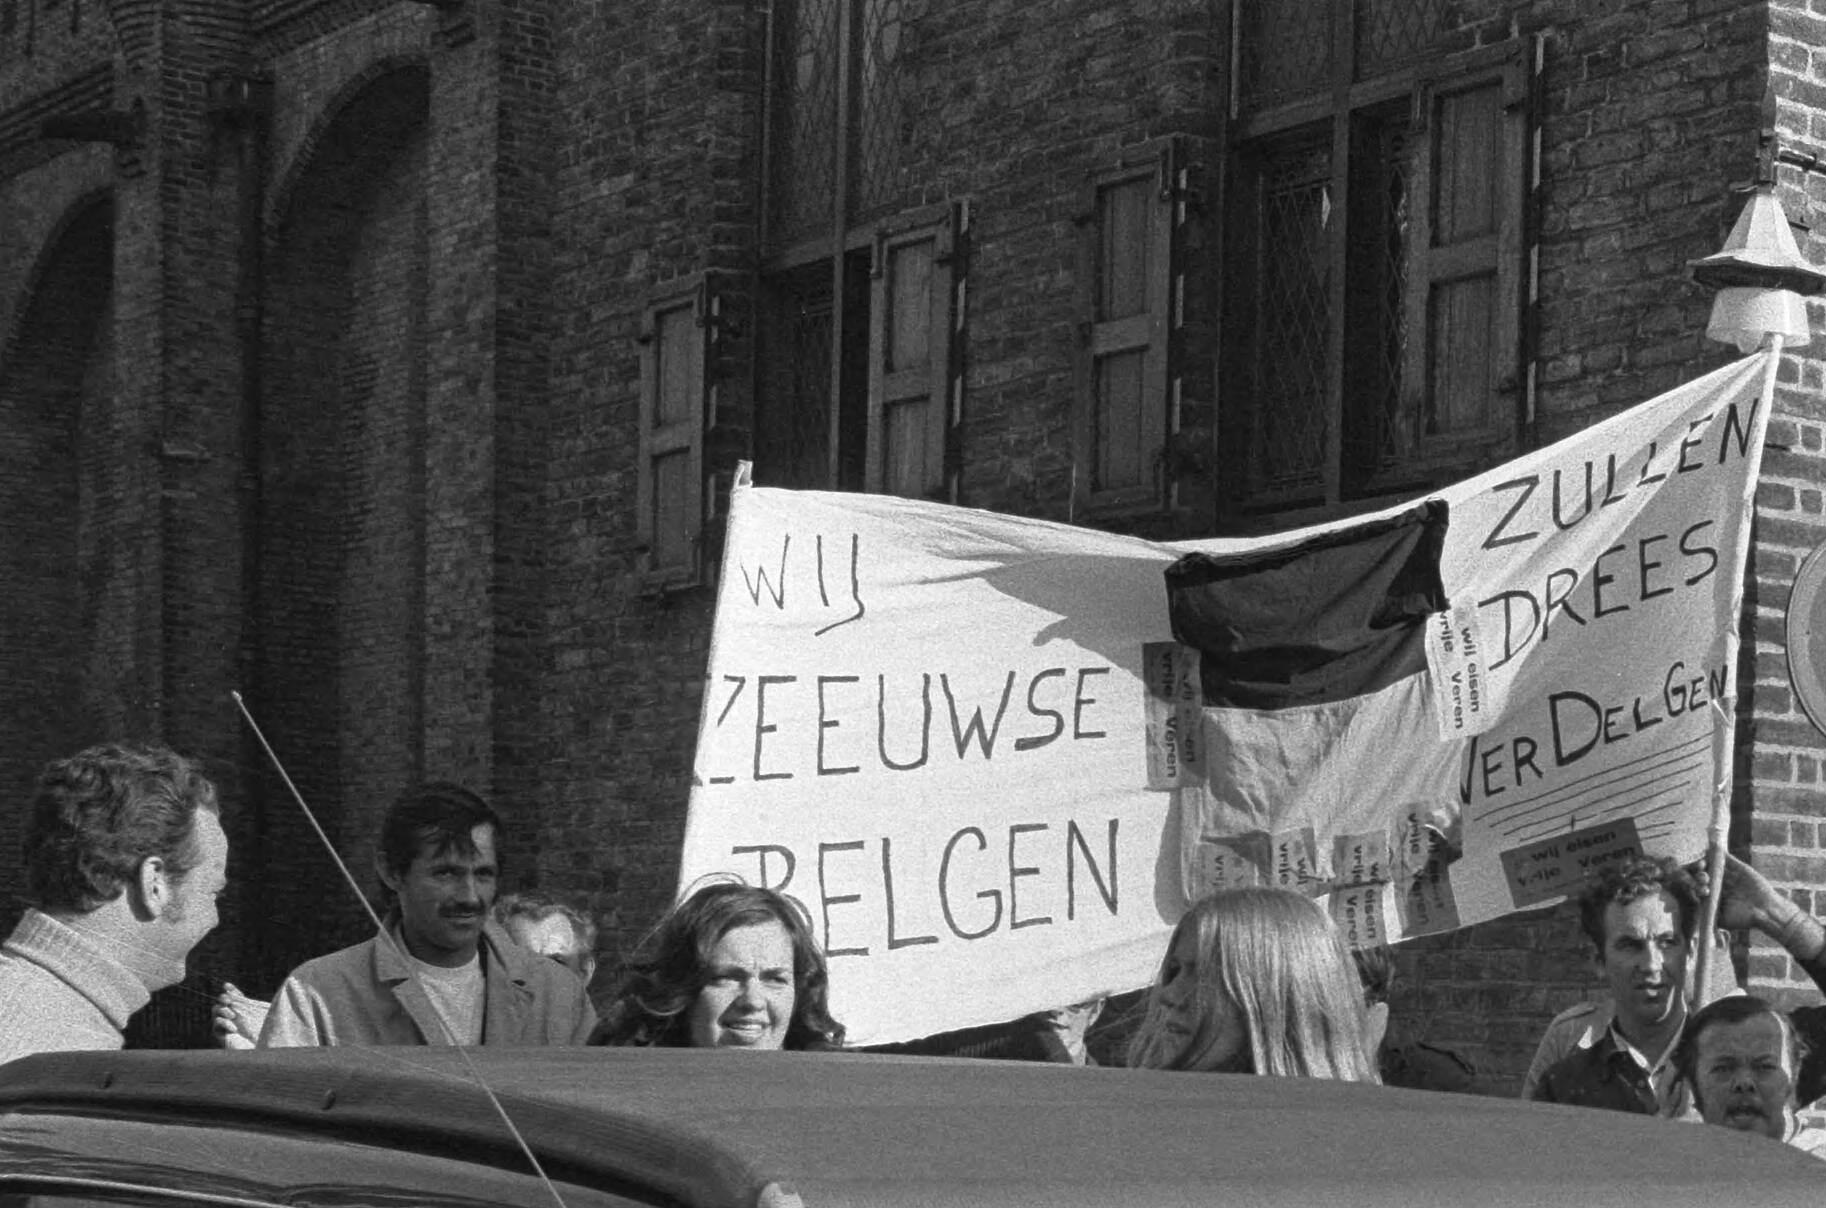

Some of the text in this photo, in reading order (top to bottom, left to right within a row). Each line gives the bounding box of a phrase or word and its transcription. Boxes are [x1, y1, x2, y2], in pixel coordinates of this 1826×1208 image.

[1480, 398, 1760, 550] ZULLEN
[740, 533, 865, 636] WIJ
[1477, 519, 1719, 672] DREES
[695, 667, 1110, 786] ZEEUWSE
